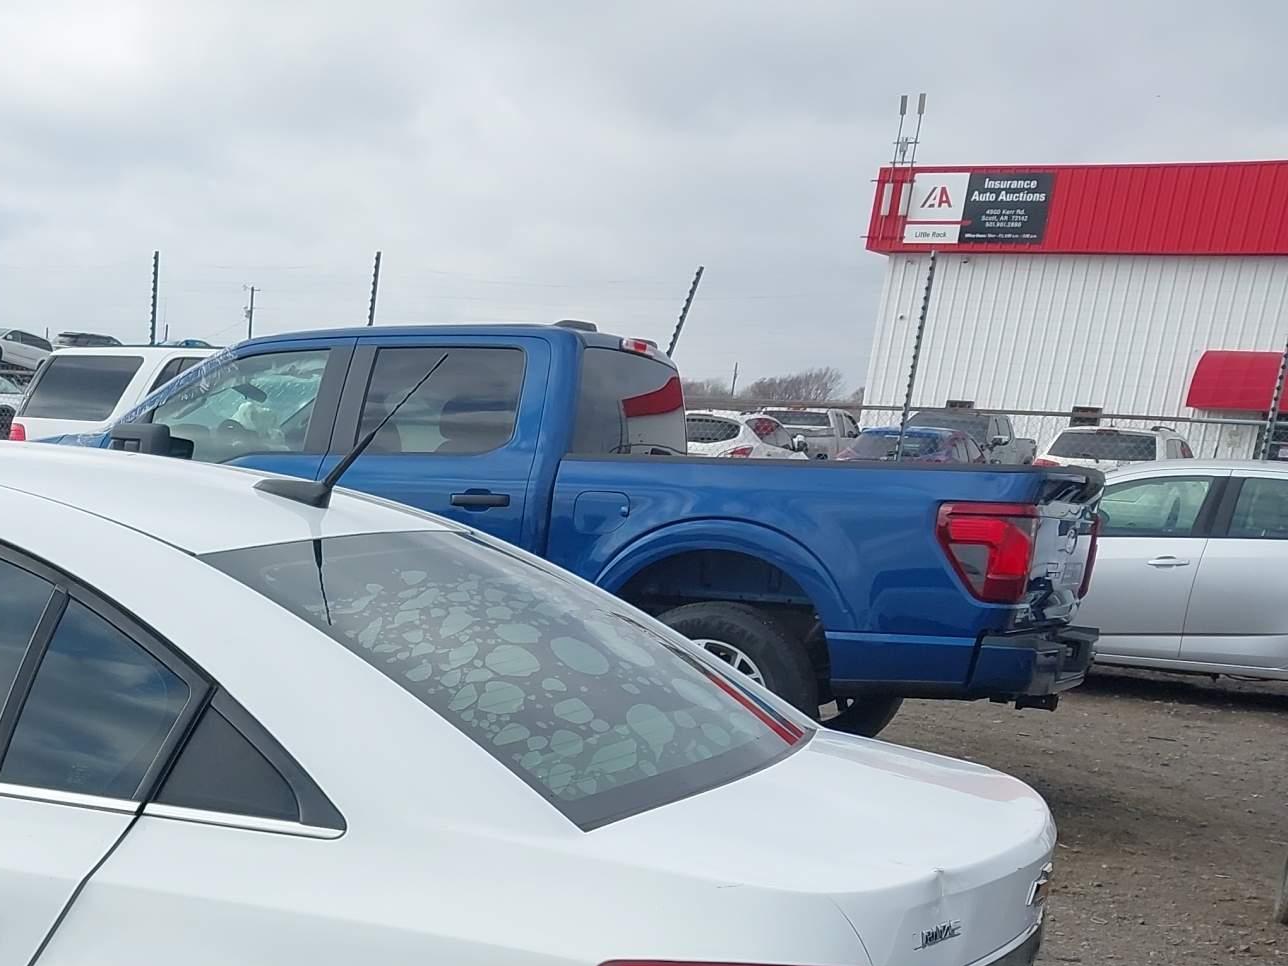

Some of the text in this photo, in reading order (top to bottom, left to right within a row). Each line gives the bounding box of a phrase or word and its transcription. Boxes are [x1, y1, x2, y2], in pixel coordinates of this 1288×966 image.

[984, 178, 1038, 189] Insurance
[971, 190, 1046, 202] Auto Auctions
